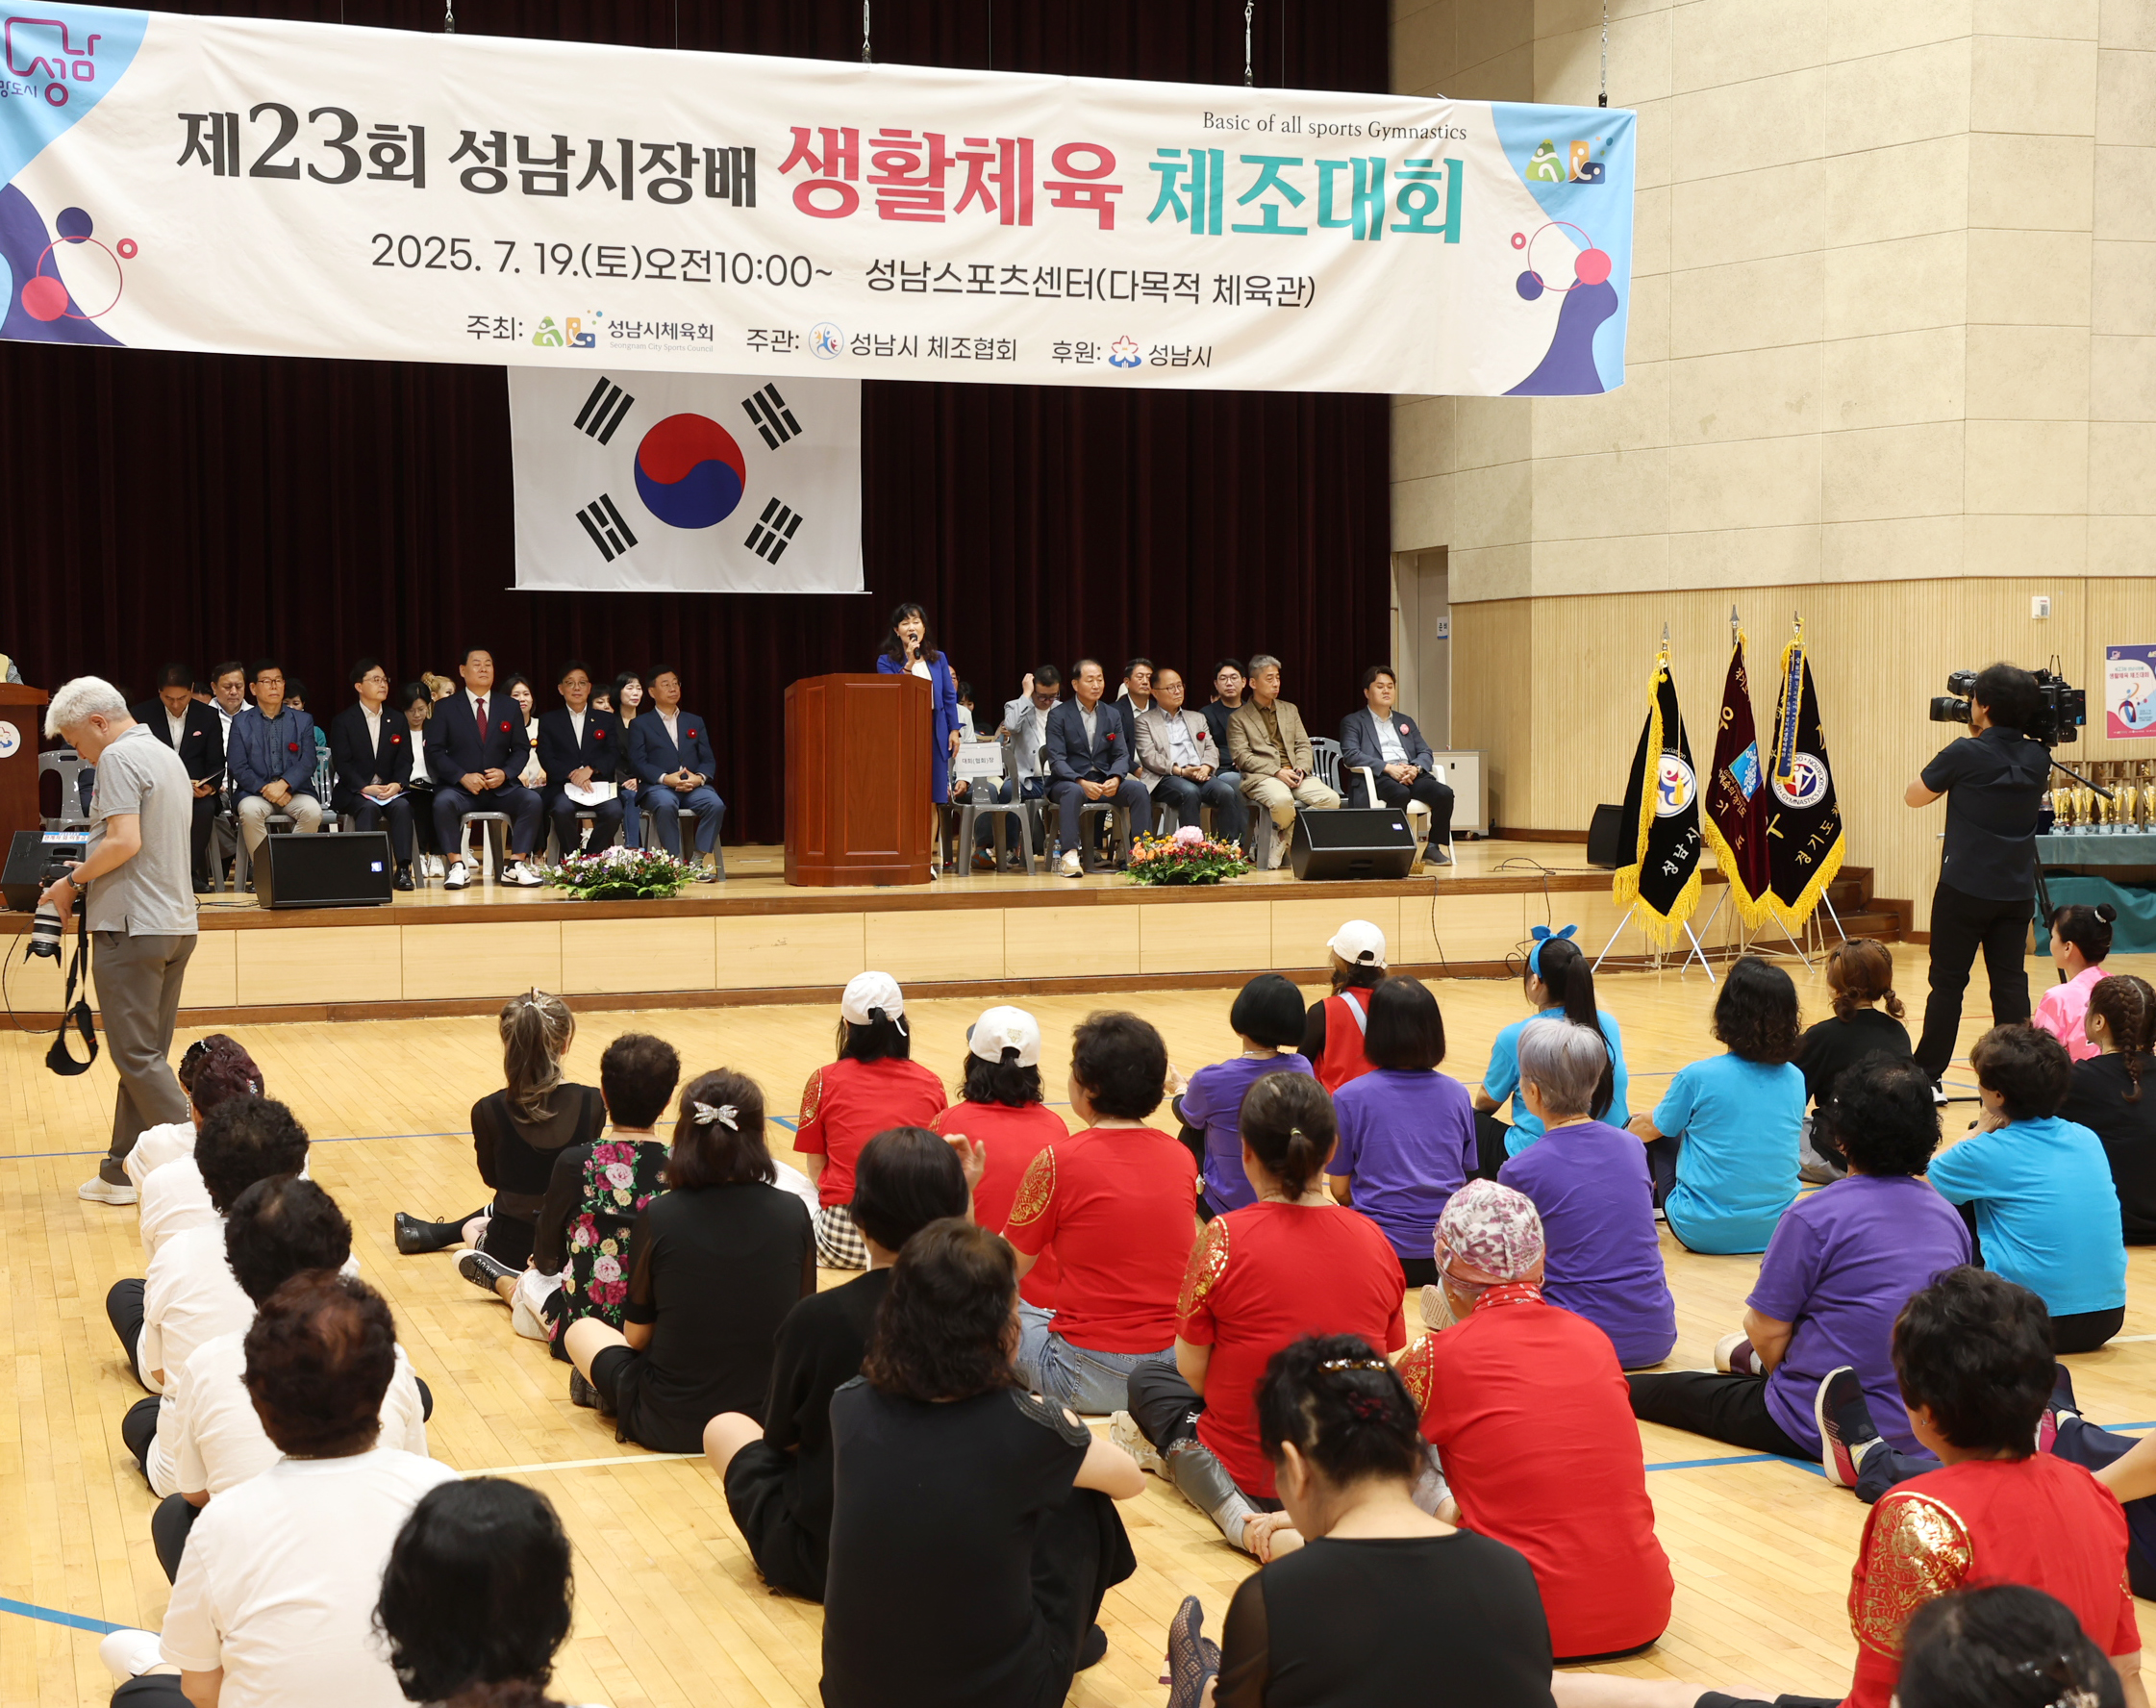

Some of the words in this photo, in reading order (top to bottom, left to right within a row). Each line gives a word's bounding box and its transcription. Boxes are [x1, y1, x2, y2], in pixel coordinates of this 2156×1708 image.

[1203, 112, 1250, 131] Basic
[1257, 114, 1276, 133] of
[1281, 115, 1301, 134] all
[1308, 122, 1362, 138] sports
[1367, 121, 1467, 141] Gymnastics
[176, 102, 426, 188] 제23회
[448, 129, 757, 208] 성남시장배
[777, 126, 1123, 230] 생활체육
[1147, 147, 1464, 244] 체조대회
[370, 233, 482, 271] 2025.
[493, 239, 520, 274] 7.
[865, 259, 1200, 305] 성남스포츠센터(다목적
[1212, 274, 1316, 308] 체육관)
[466, 314, 523, 341] 주최:
[608, 319, 714, 342] 성남시체육회
[746, 327, 800, 354] 주관:
[610, 341, 647, 351] Seongnam
[648, 342, 663, 352] City
[664, 343, 686, 353] Sports
[687, 344, 714, 353] Council
[850, 332, 918, 359] 성남시
[927, 335, 1017, 362] 체조협회
[1052, 339, 1101, 364] 후원:
[1148, 344, 1212, 368] 성남시
